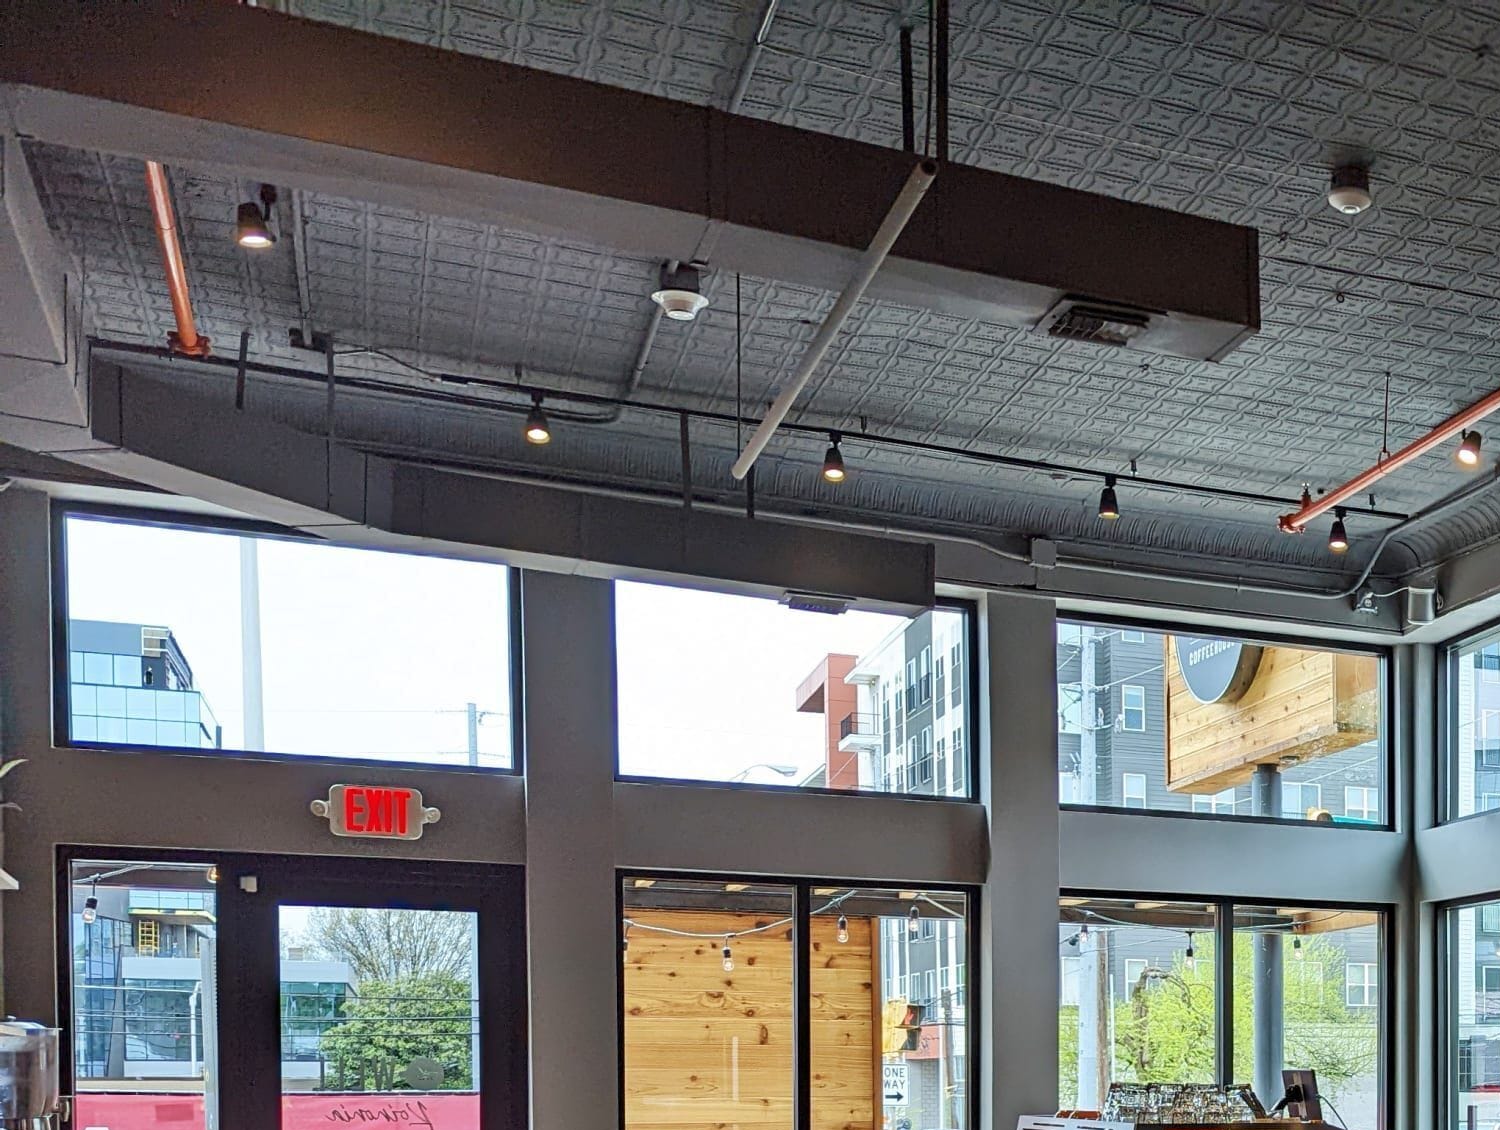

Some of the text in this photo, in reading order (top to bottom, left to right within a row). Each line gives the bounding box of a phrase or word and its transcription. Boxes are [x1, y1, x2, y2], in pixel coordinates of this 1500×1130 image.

[1189, 640, 1235, 666] COFFEEHOUS
[345, 787, 411, 834] EXIT
[884, 1067, 905, 1078] ONE
[884, 1079, 905, 1089] WAY
